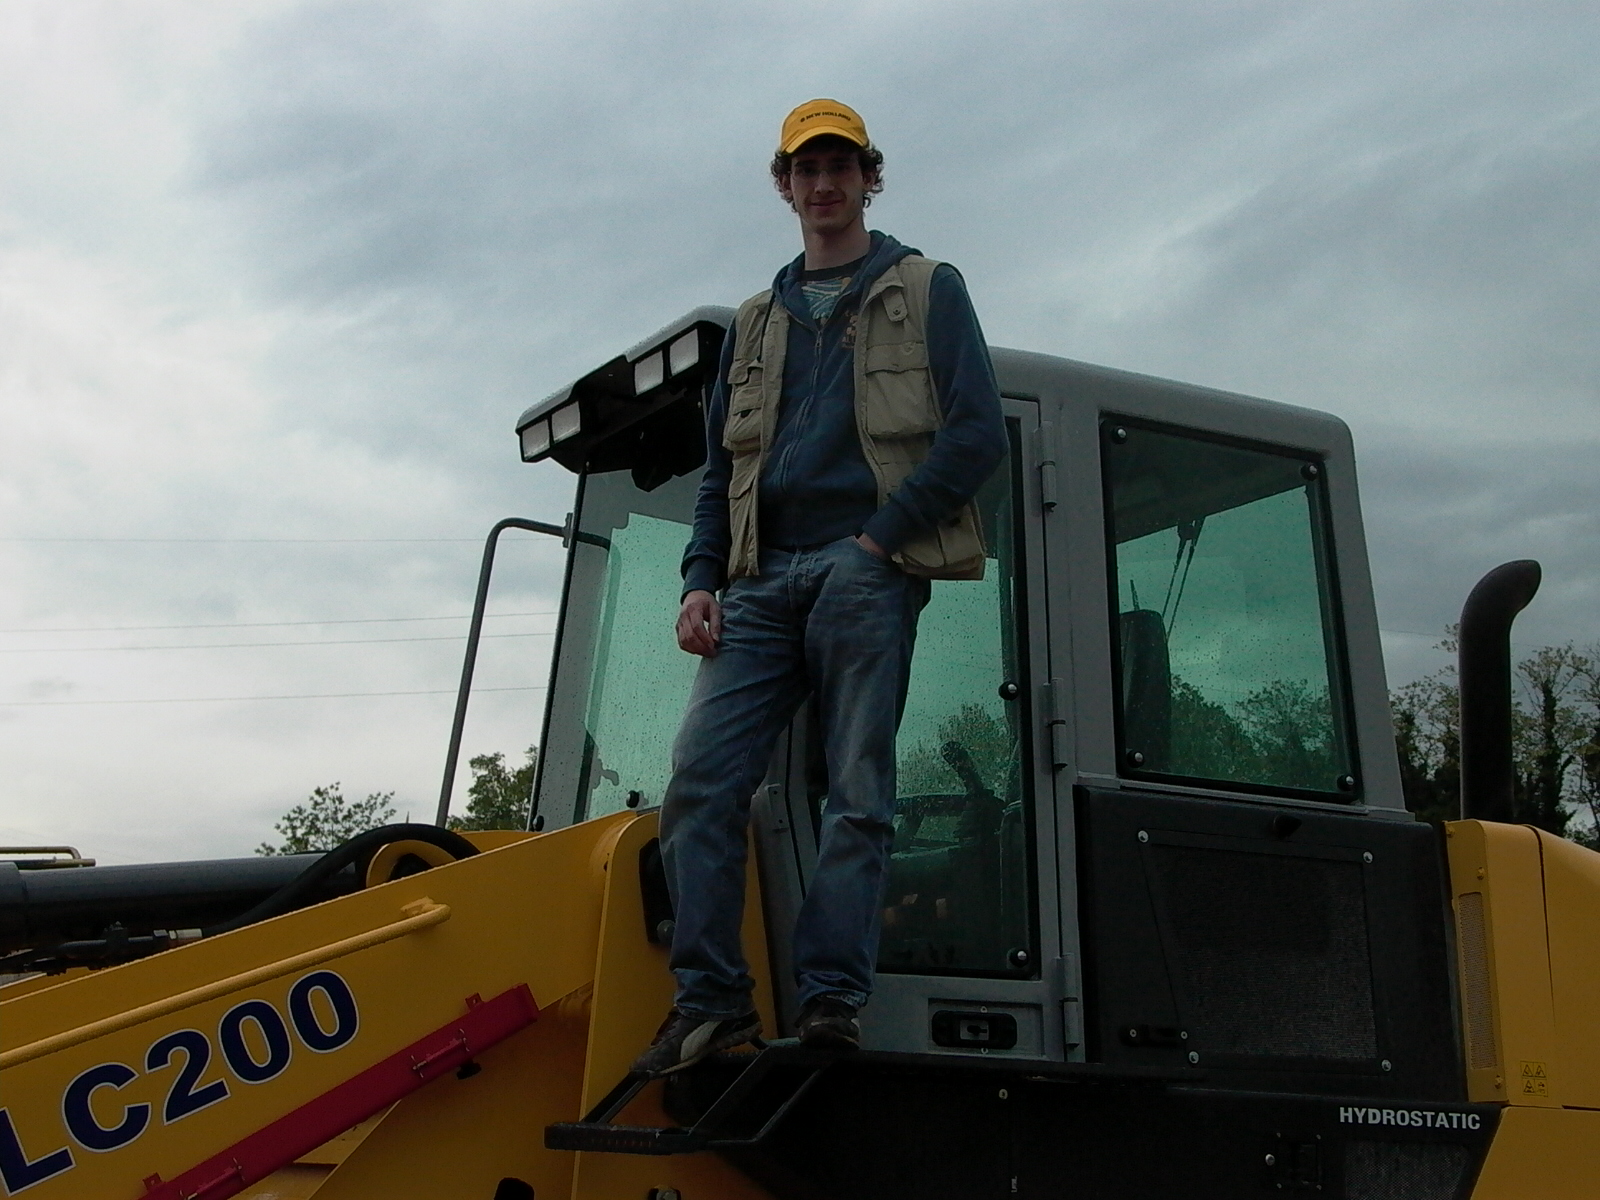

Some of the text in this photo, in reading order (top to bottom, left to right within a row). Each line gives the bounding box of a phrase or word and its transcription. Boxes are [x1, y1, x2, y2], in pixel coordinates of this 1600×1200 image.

[806, 111, 851, 121] NEW HOLLAND
[1339, 1106, 1481, 1131] HYDROSTATIC
